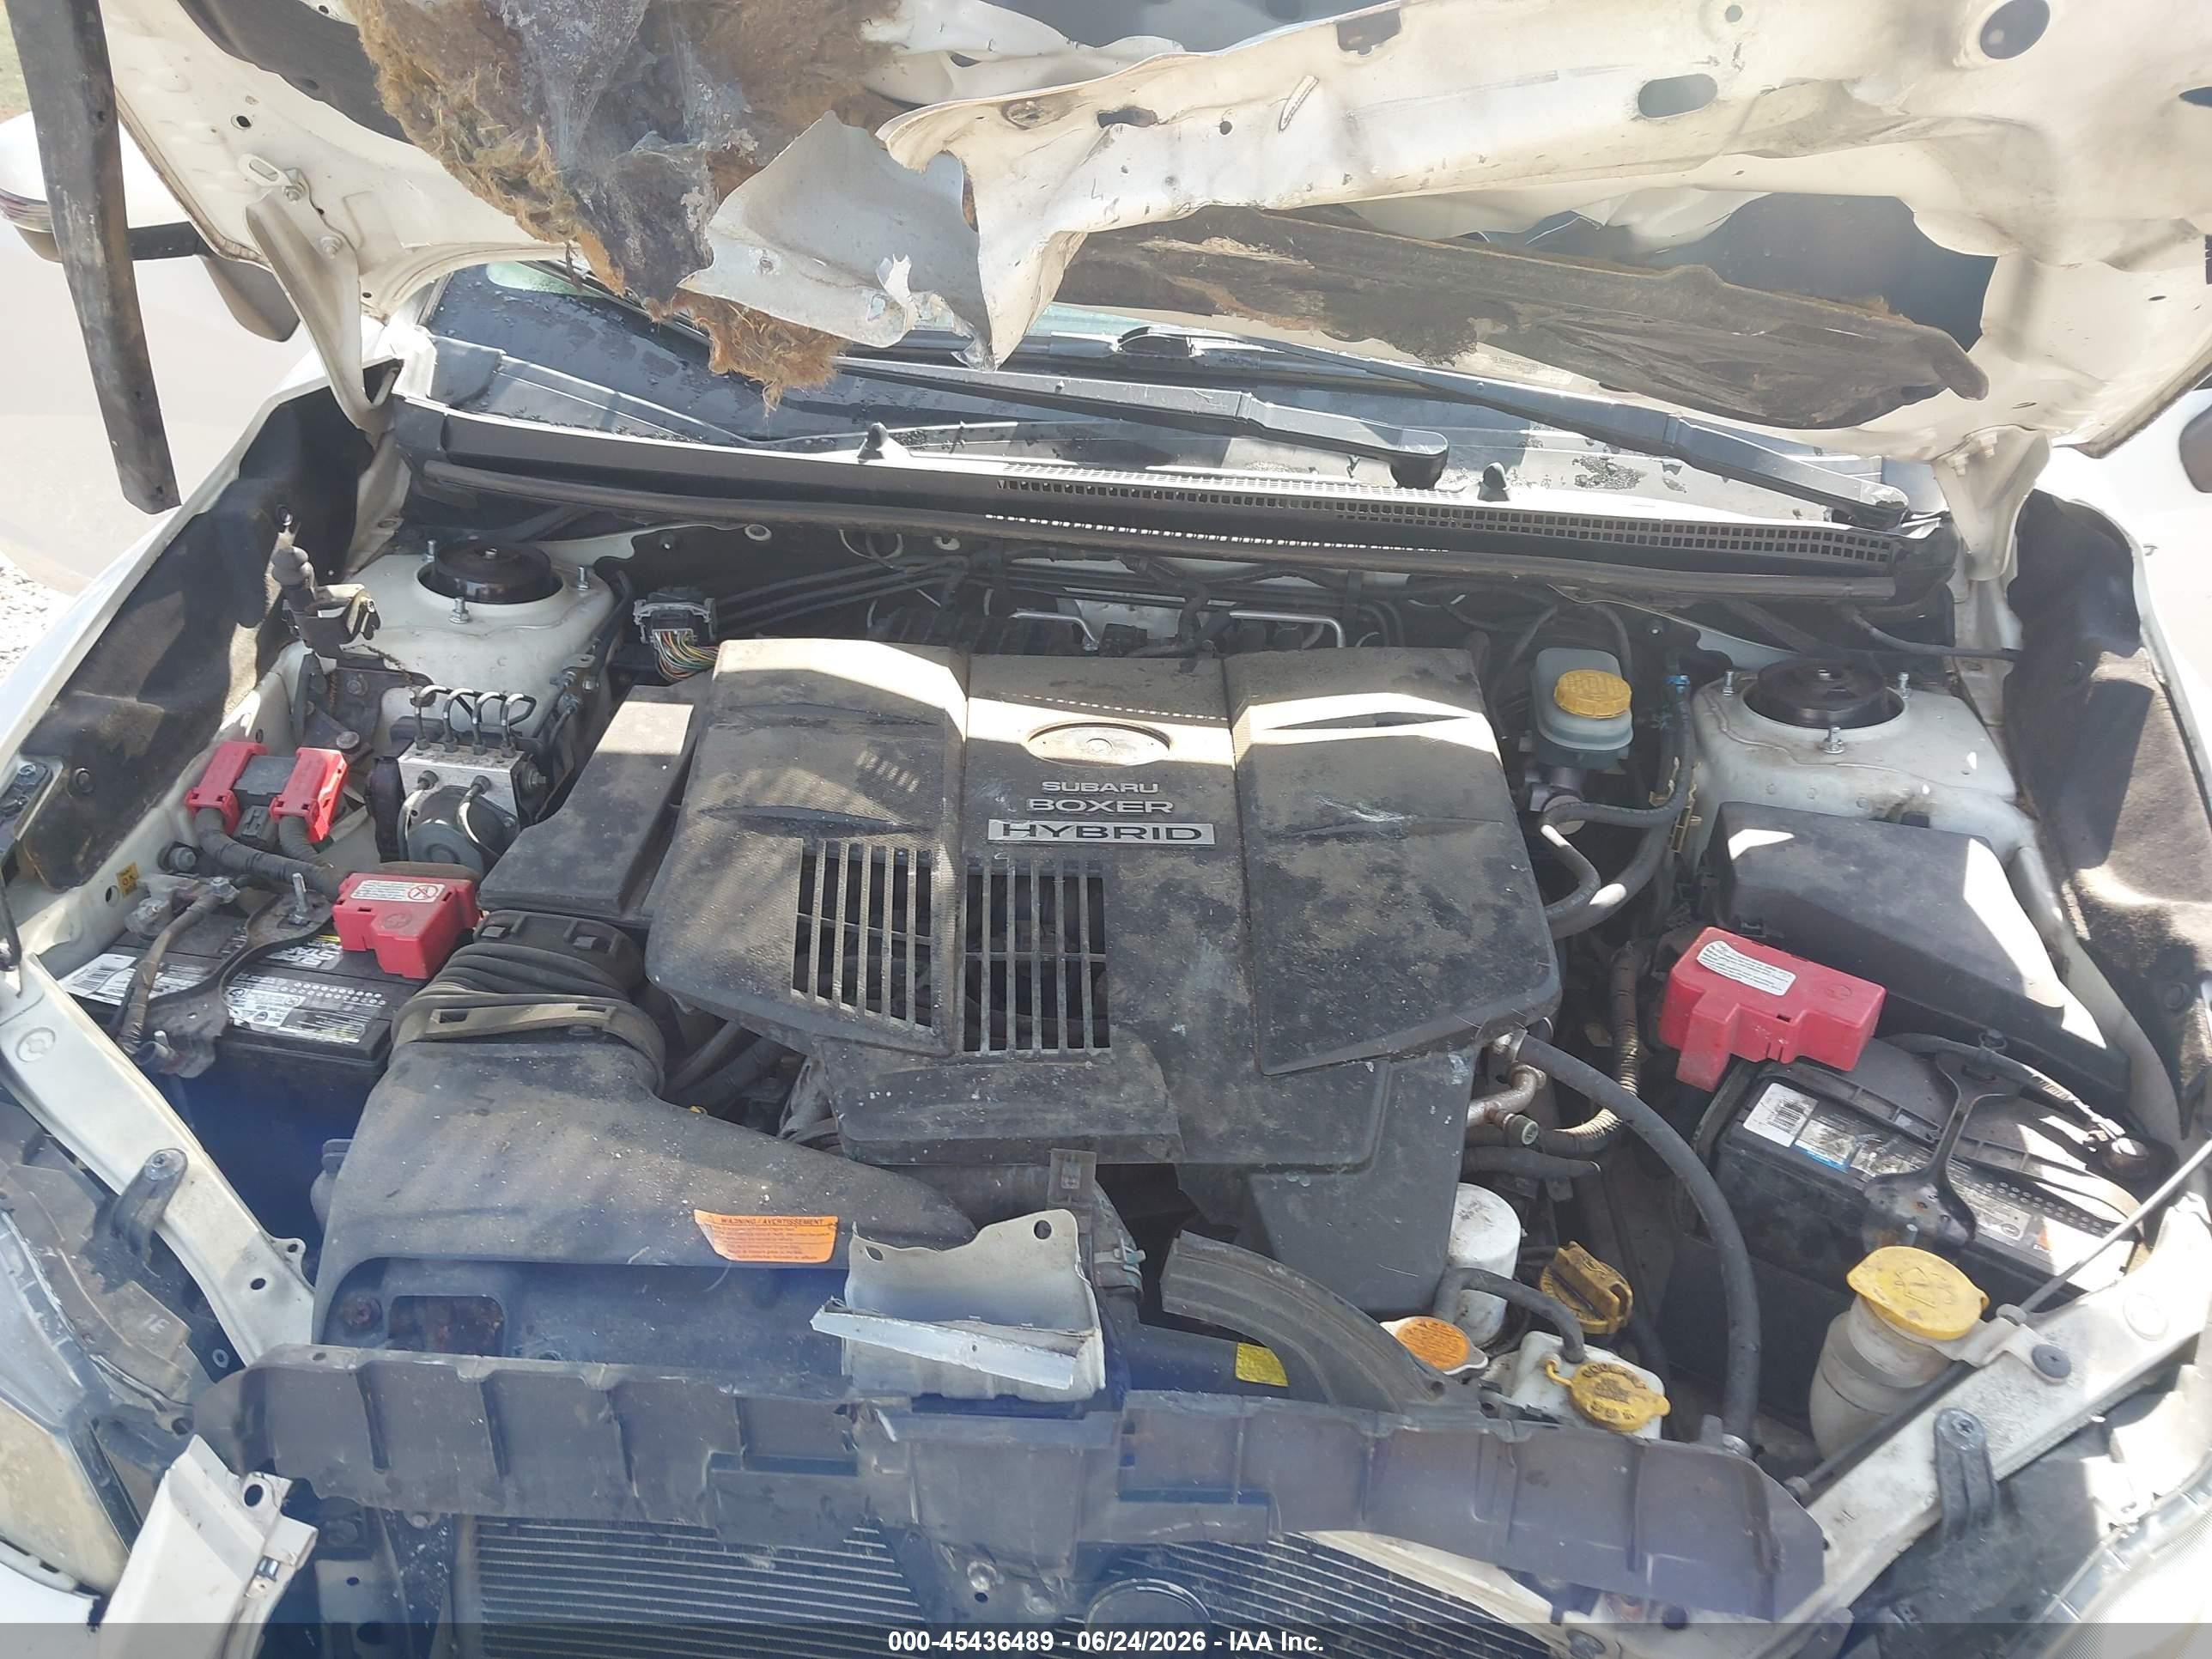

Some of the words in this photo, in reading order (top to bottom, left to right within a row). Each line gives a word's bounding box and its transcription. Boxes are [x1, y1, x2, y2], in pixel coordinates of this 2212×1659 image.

[1041, 781, 1159, 793] SUBARU
[1028, 799, 1174, 813] BOXER
[1002, 823, 1202, 841] HYBRID
